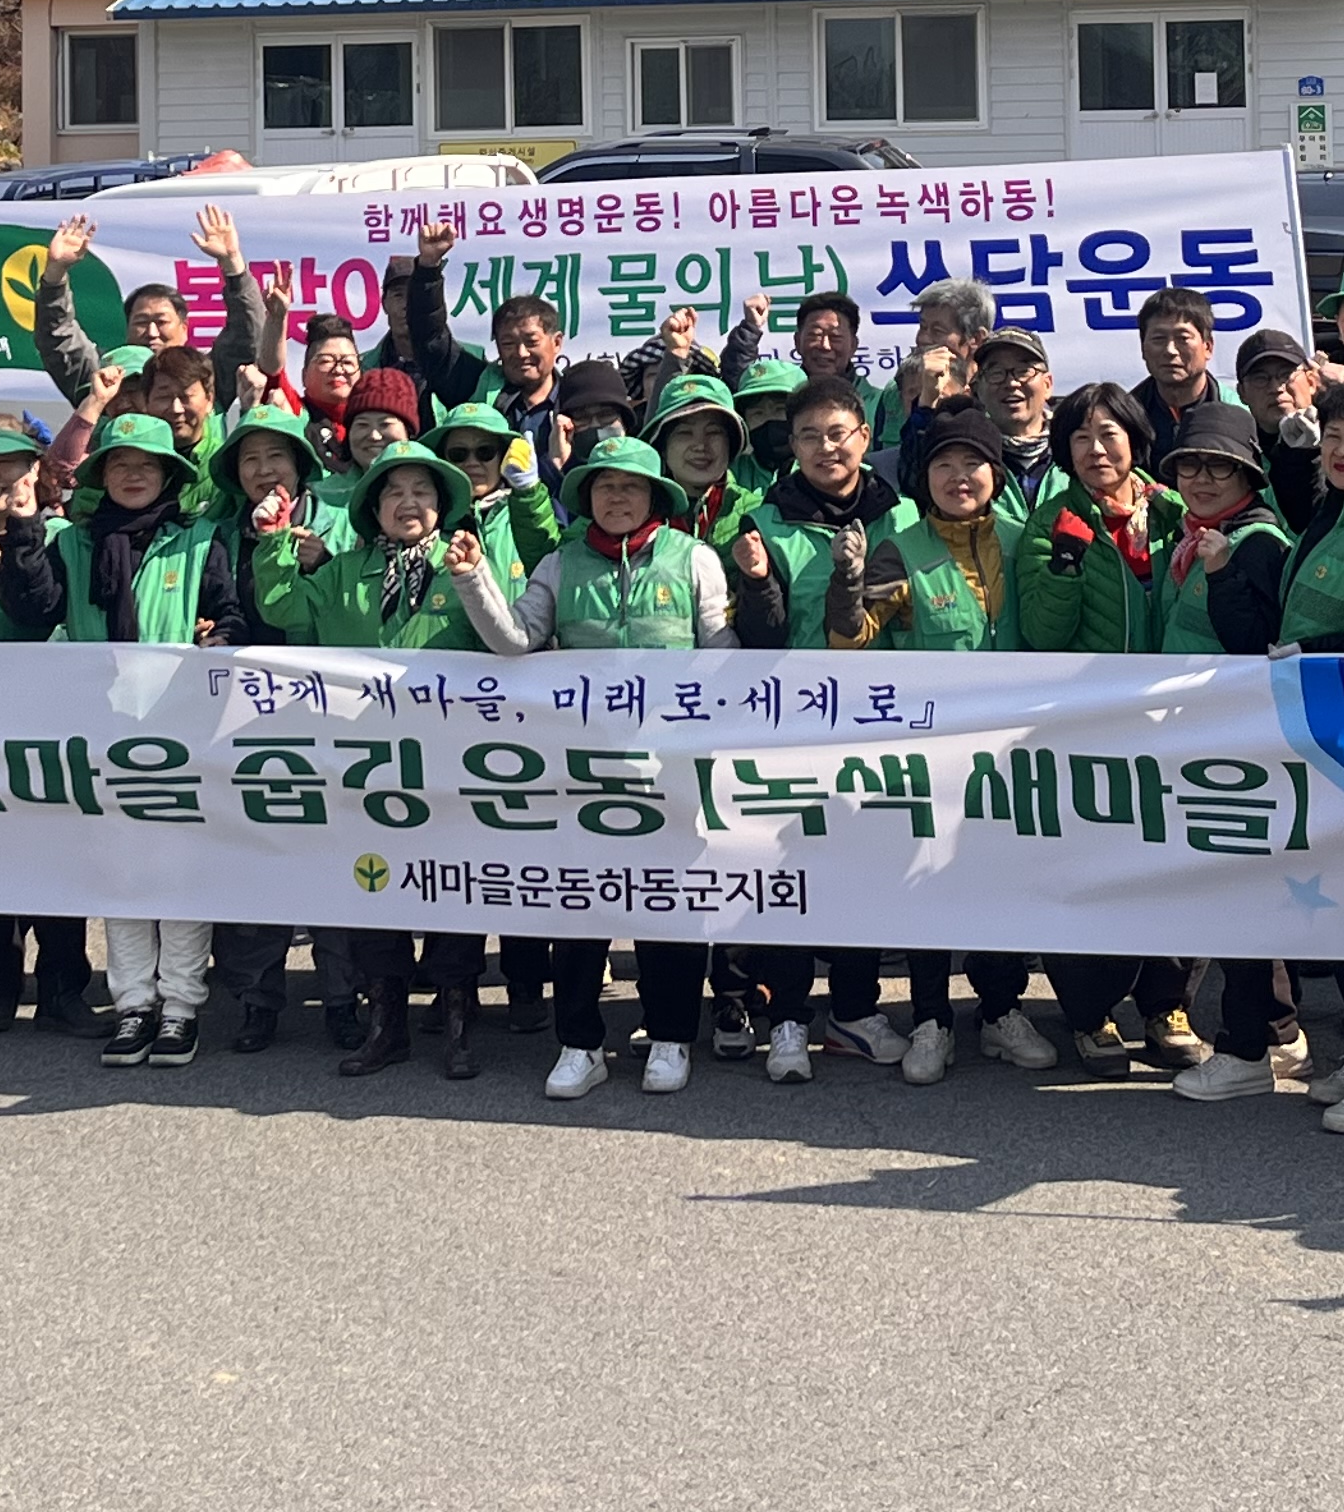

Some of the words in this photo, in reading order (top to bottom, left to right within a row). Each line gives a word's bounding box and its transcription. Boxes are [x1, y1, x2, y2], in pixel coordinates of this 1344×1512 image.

[363, 201, 505, 243] 함께해요
[518, 191, 681, 238] 생명운동!
[709, 185, 863, 229] 아름다운
[876, 178, 1055, 224] 녹색하동!
[598, 246, 732, 338] 물의
[871, 228, 1274, 334] 쓰담운동
[358, 672, 525, 723] 새마을,
[231, 737, 432, 829] 줍깅
[458, 741, 666, 837] 운동
[400, 858, 808, 915] 새마을운동하동군지회
